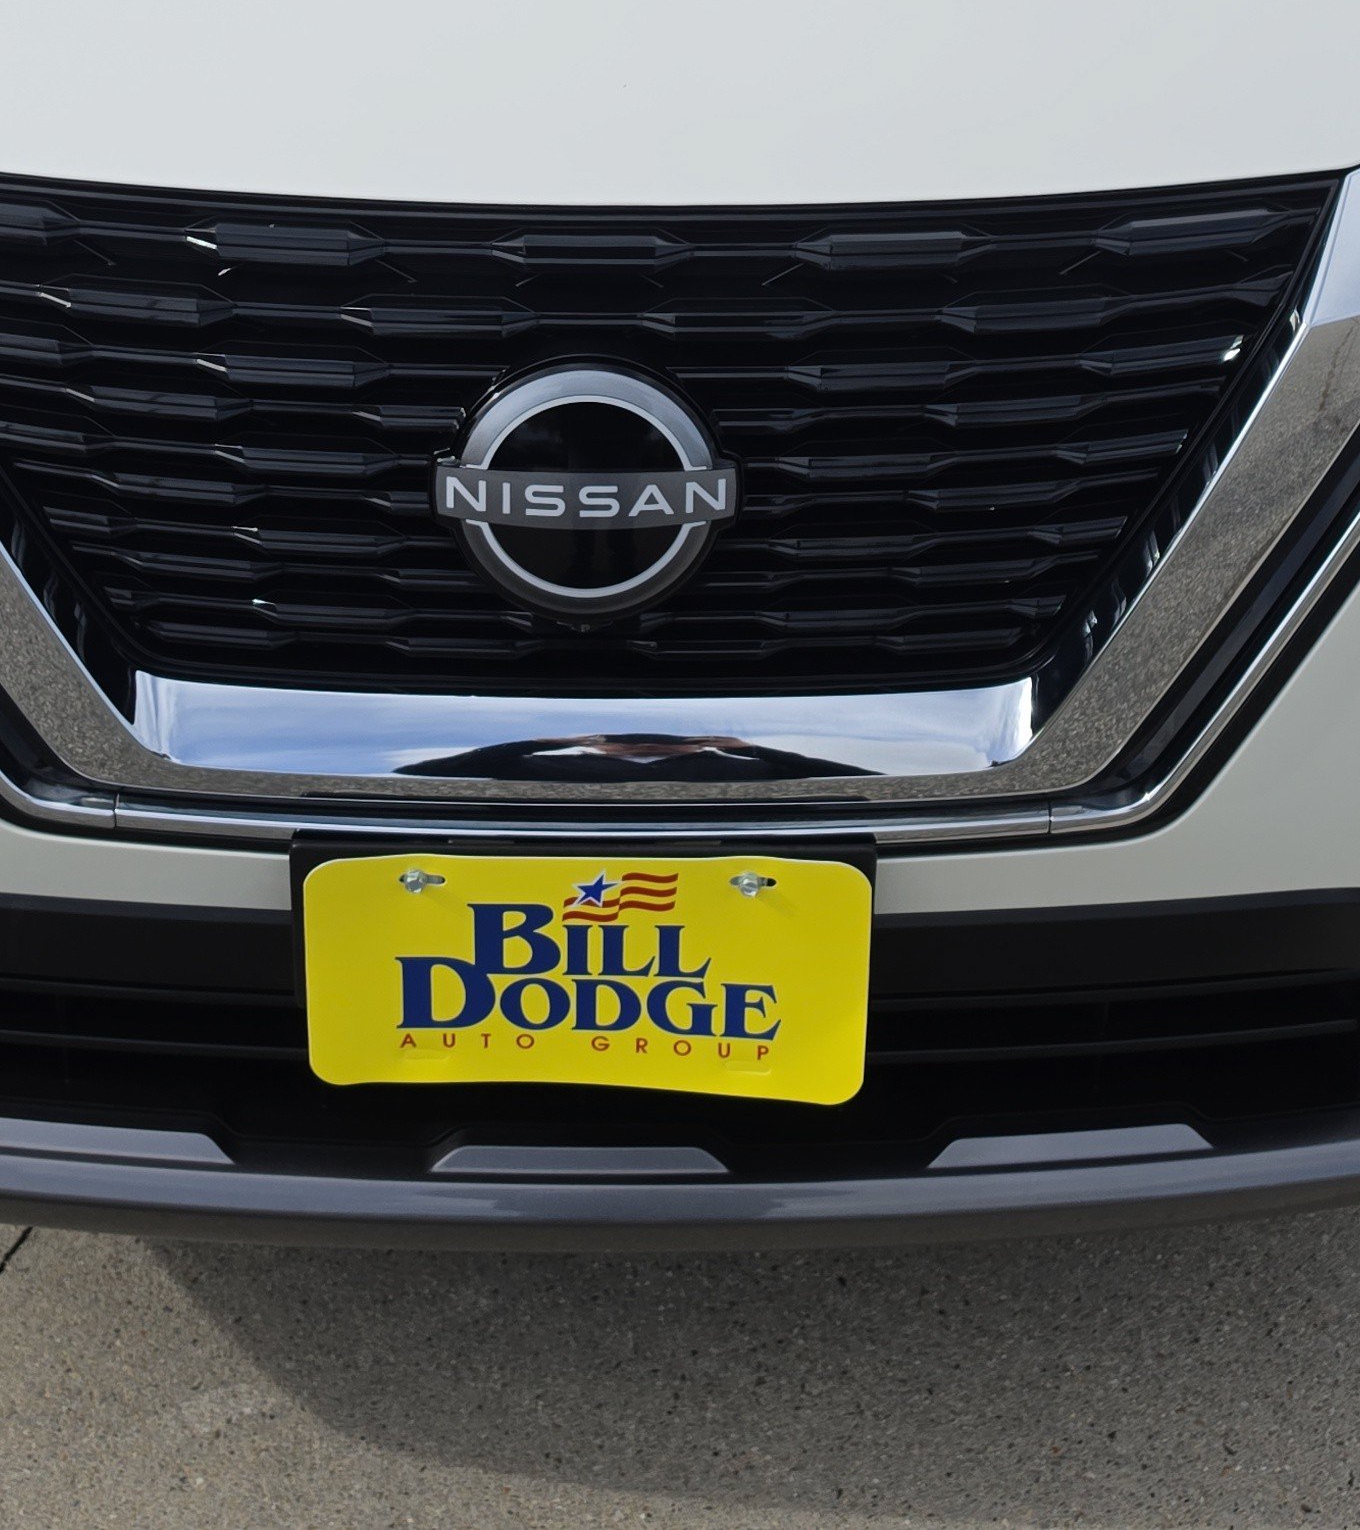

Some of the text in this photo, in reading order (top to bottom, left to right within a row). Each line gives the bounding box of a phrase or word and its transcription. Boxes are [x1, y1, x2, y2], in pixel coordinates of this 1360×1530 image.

[445, 476, 727, 518] NISSAN
[466, 903, 711, 978] BILL
[395, 956, 782, 1040] DODGE
[399, 1032, 770, 1061] AUTO GROUP
